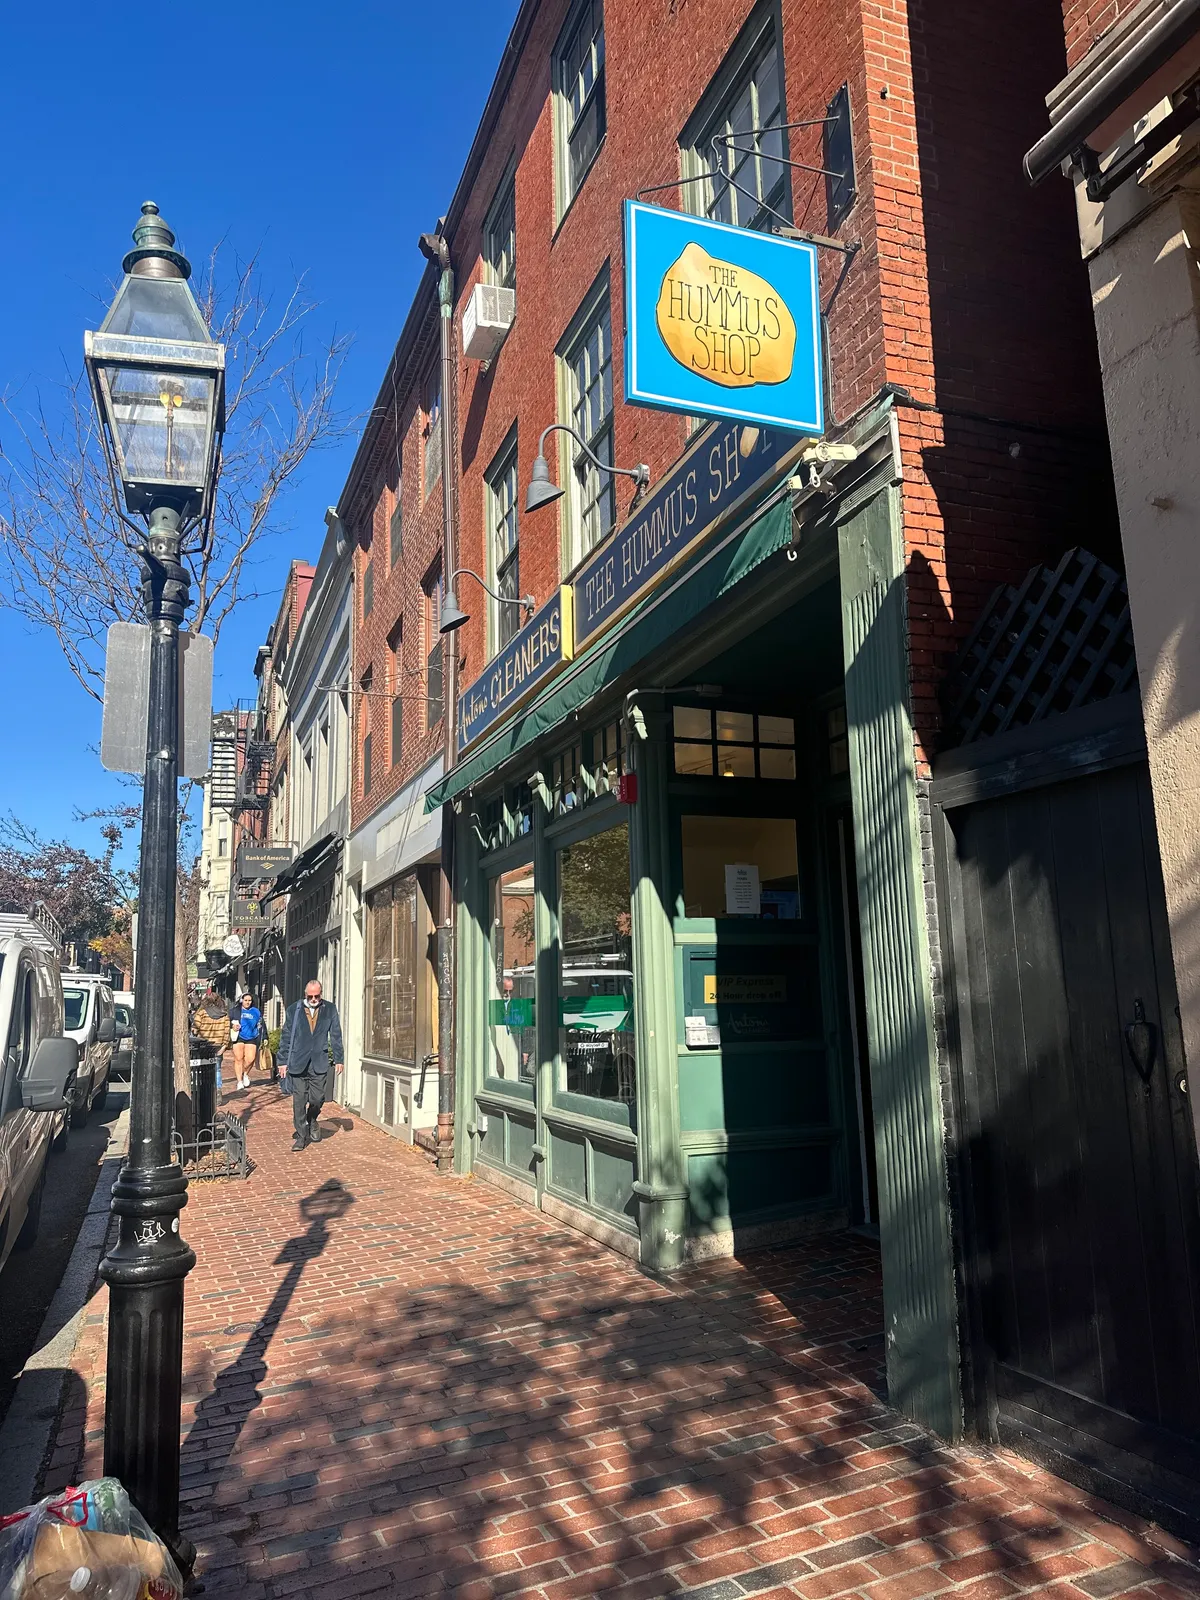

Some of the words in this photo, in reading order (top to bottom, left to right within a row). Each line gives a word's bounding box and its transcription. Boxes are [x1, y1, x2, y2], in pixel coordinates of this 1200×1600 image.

[709, 265, 738, 288] THE
[667, 278, 781, 340] HUMMUS
[691, 325, 761, 378] SHOP
[585, 556, 615, 622] THE
[621, 469, 698, 588] HUMMUS
[459, 684, 488, 743] Anton's
[490, 608, 560, 709] CLEANERS
[709, 992, 721, 1000] 24
[723, 992, 745, 1000] Hour
[746, 991, 766, 1001] drop
[768, 991, 782, 1000] off
[717, 977, 734, 987] VIP
[736, 976, 775, 987] Express
[725, 1011, 771, 1034] Anton's
